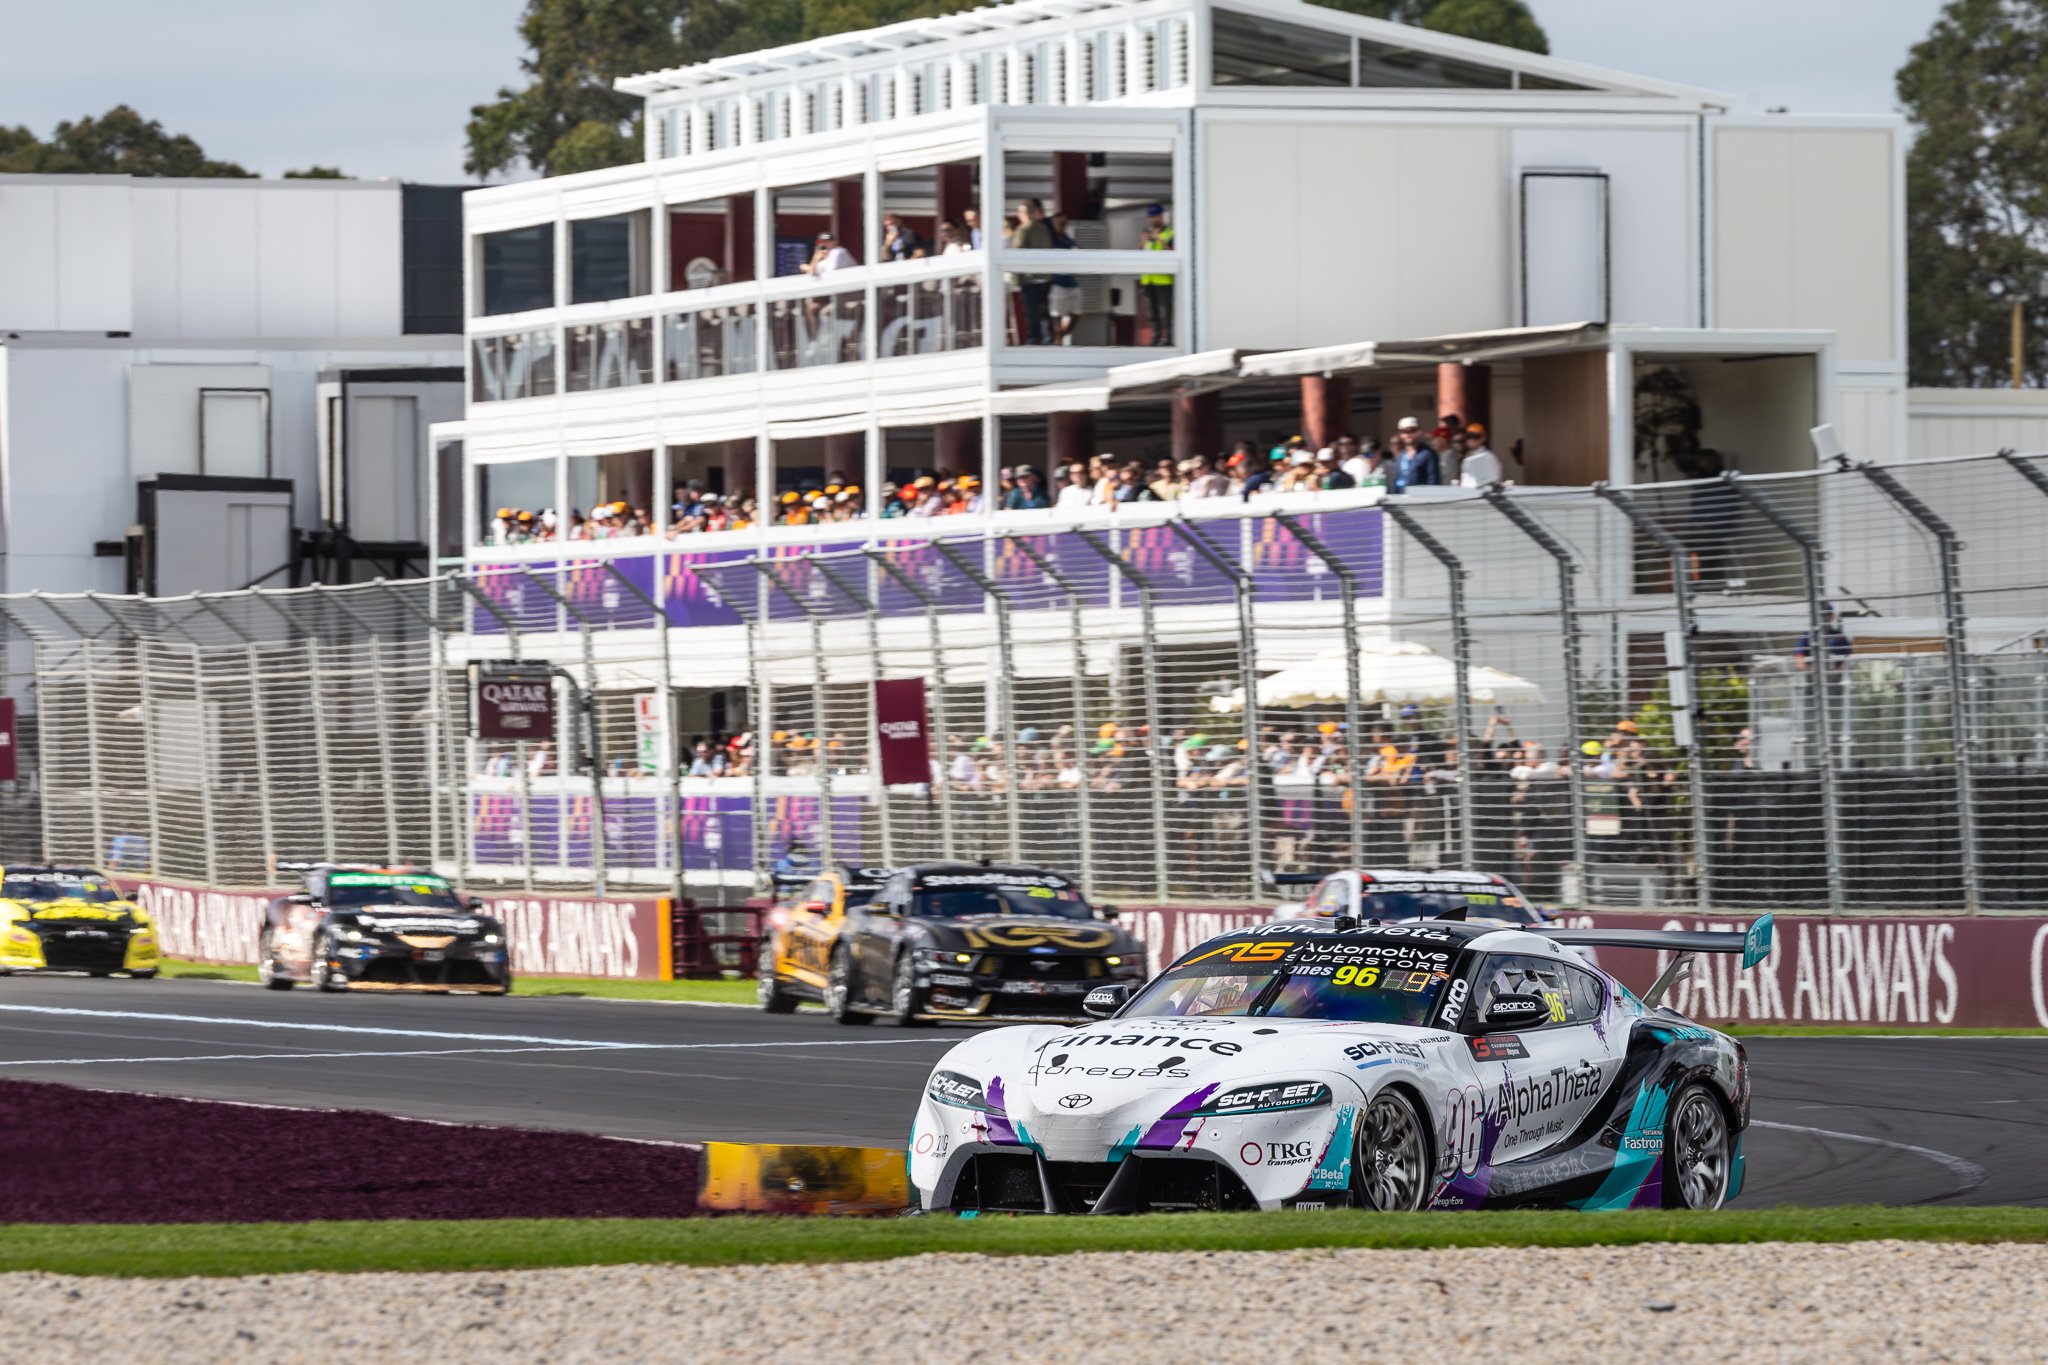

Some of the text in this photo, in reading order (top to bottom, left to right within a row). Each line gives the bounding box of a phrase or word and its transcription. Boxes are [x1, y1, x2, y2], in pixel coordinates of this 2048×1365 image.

[1292, 941, 1449, 961] Automotive
[1284, 954, 1448, 972] SUPERSTORE
[1793, 922, 1957, 1023] AIRWAYS
[1272, 963, 1380, 987] ones 96
[1441, 979, 1469, 1026] RYCO
[1493, 1001, 1536, 1012] sparco
[1544, 992, 1566, 1022] 96
[1034, 1032, 1243, 1056] Finance
[1419, 1036, 1451, 1044] DUNLOP
[1343, 1041, 1426, 1061] SCI-FLEET
[1027, 1064, 1190, 1079] coregas
[931, 1073, 982, 1099] SCI-FLEET
[1495, 1065, 1602, 1127] AlphaTheta
[1257, 1096, 1317, 1109] AUTOMOTIVE
[1440, 1084, 1486, 1182] 96
[1504, 1119, 1565, 1149] One Through Music
[1624, 1136, 1663, 1149] Fastron
[1266, 1141, 1313, 1160] TRG
[1267, 1156, 1312, 1167] transport
[1321, 1168, 1344, 1180] Beta
